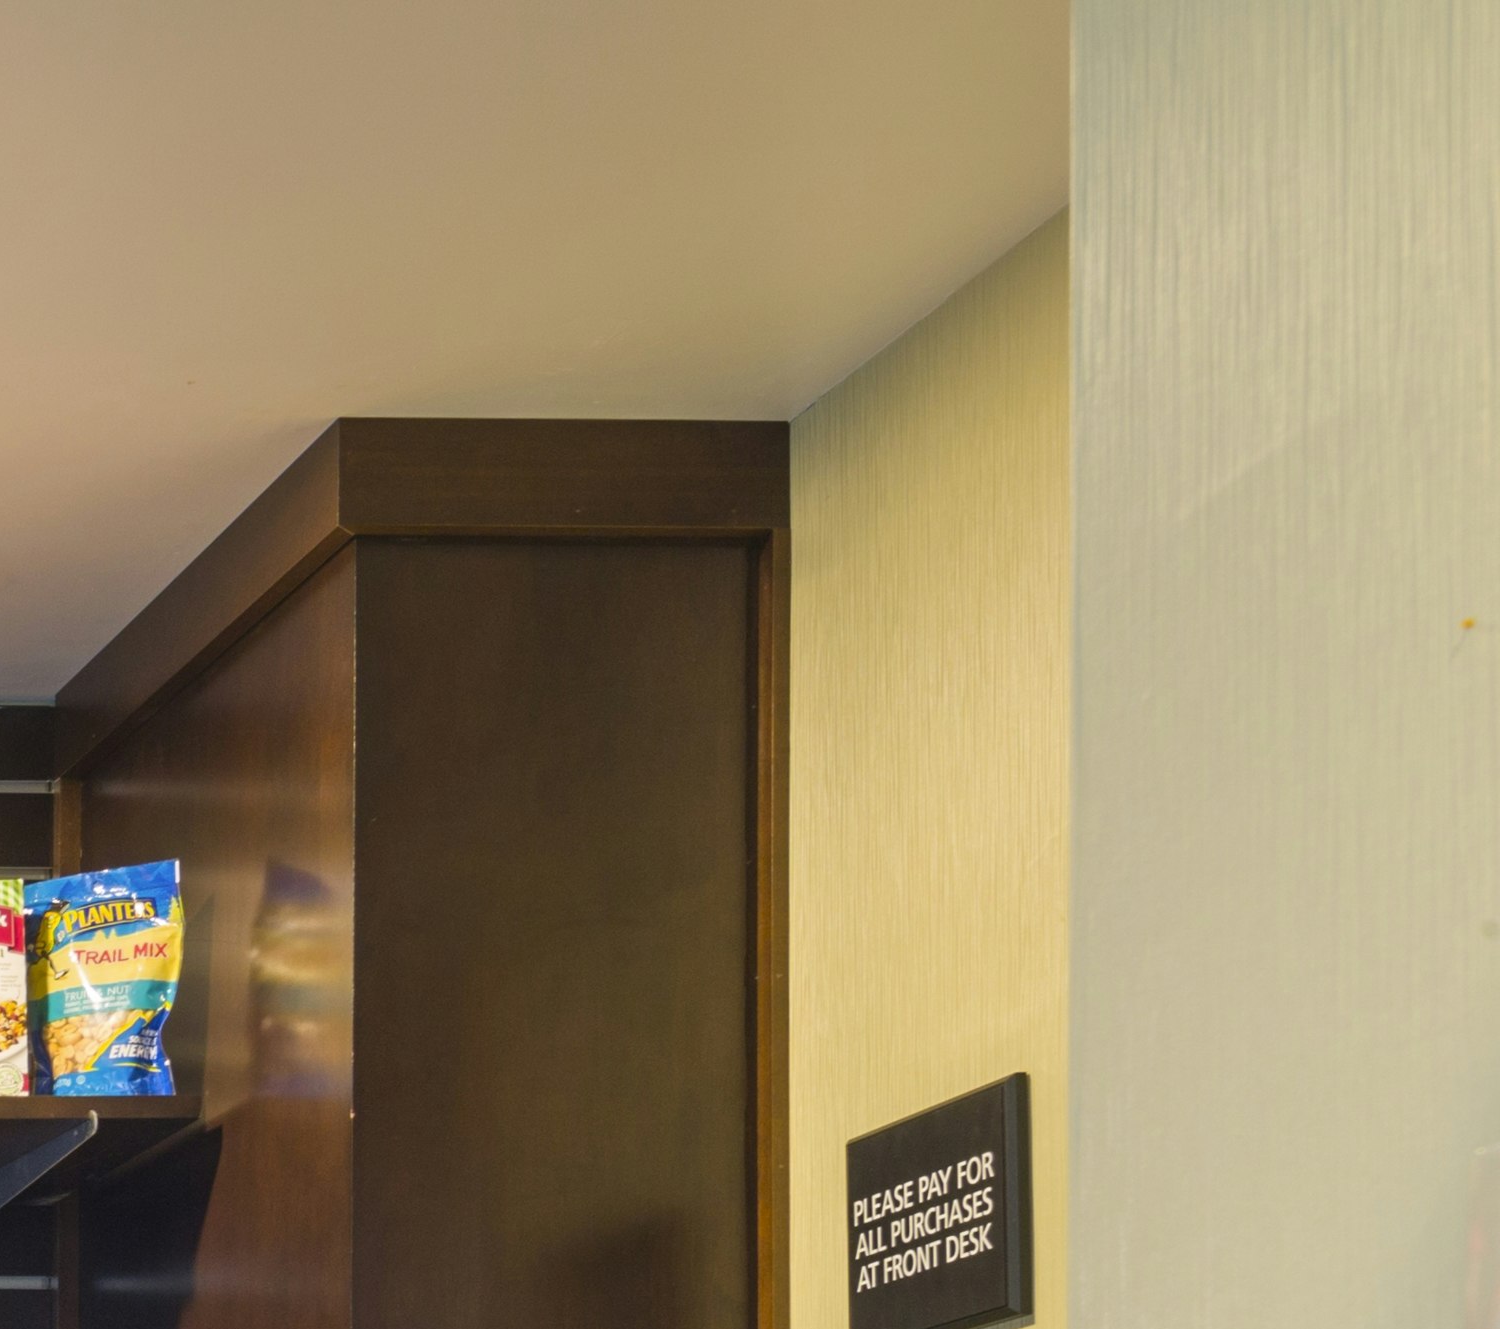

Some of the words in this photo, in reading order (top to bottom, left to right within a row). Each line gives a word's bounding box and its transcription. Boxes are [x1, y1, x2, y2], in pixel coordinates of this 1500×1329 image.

[63, 900, 156, 934] PLANTERS
[74, 947, 129, 967] TRAIL
[133, 942, 168, 960] MIX
[853, 1181, 914, 1228] PLEASE
[918, 1165, 952, 1203] PAY
[957, 1151, 995, 1190] FOR
[855, 1226, 887, 1260] ALL
[890, 1186, 994, 1248] PURCHASES
[857, 1261, 880, 1293] AT
[883, 1239, 942, 1284] FRONT
[945, 1223, 993, 1264] DESK
